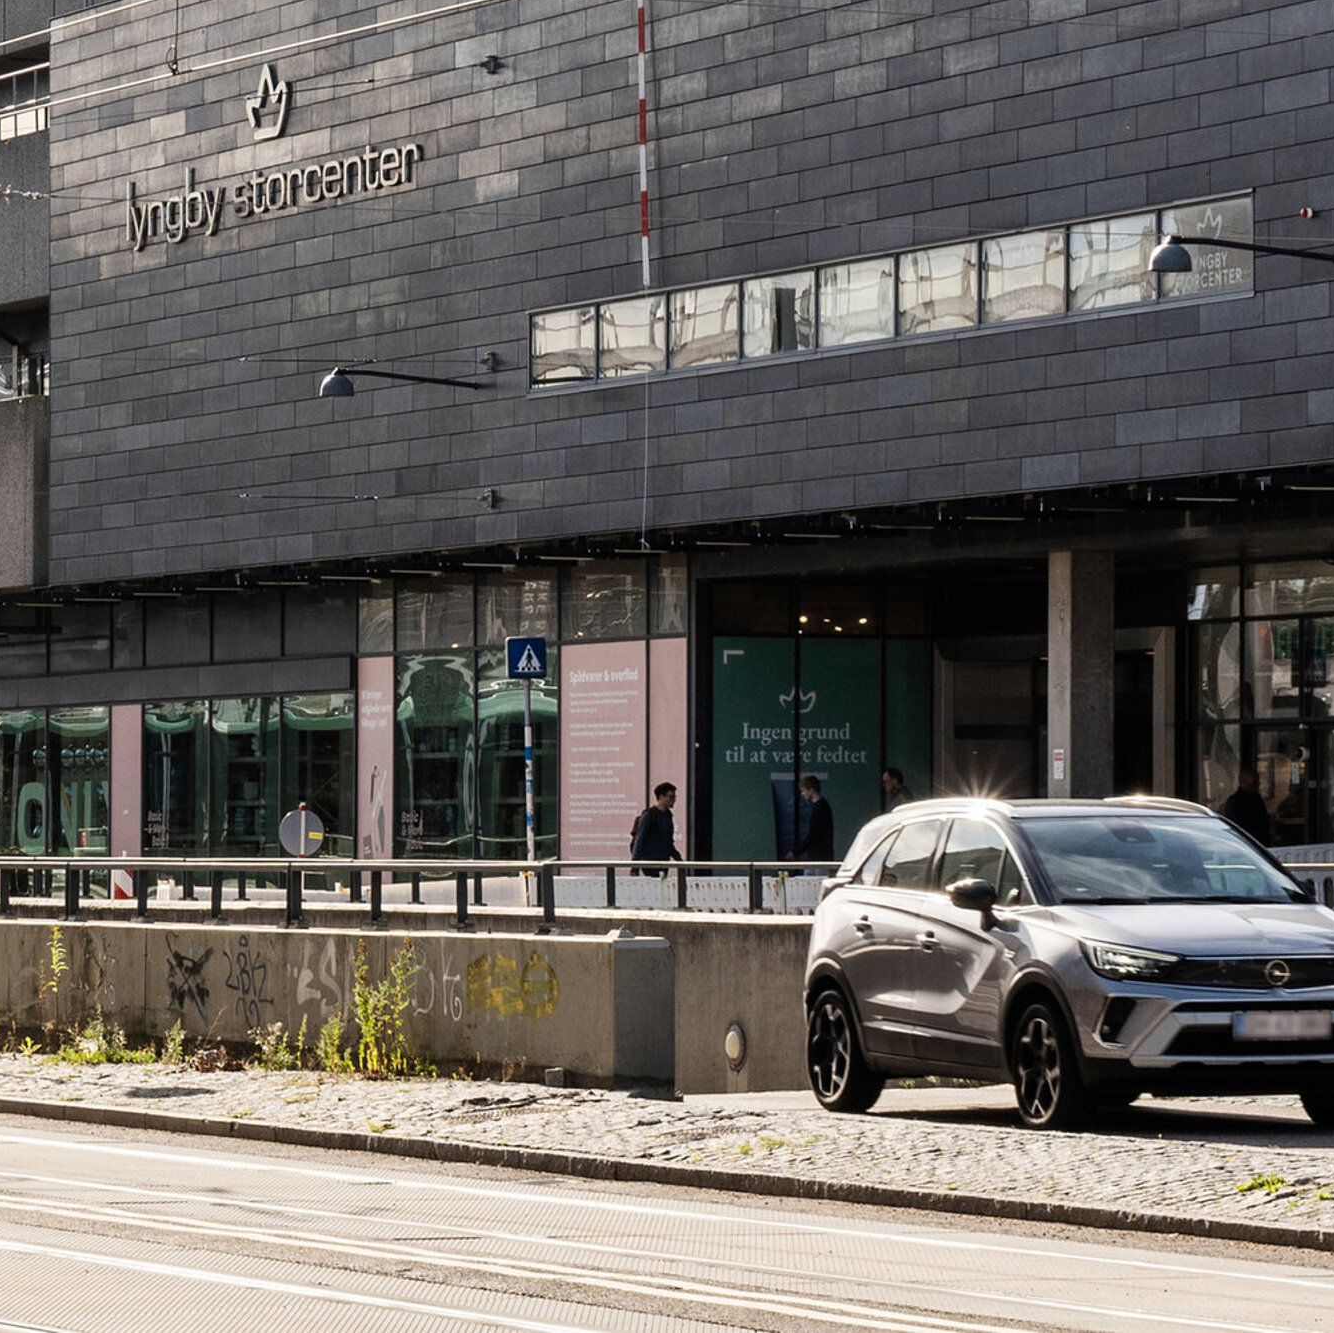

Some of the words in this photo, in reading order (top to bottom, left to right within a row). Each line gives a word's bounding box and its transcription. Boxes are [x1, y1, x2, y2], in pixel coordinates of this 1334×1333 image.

[126, 167, 224, 252] lyngby
[233, 143, 421, 218] storcenter
[742, 722, 792, 746] Ingen
[799, 722, 851, 746] grund
[725, 745, 745, 763] til
[750, 749, 767, 763] at
[817, 745, 869, 764] fedtet
